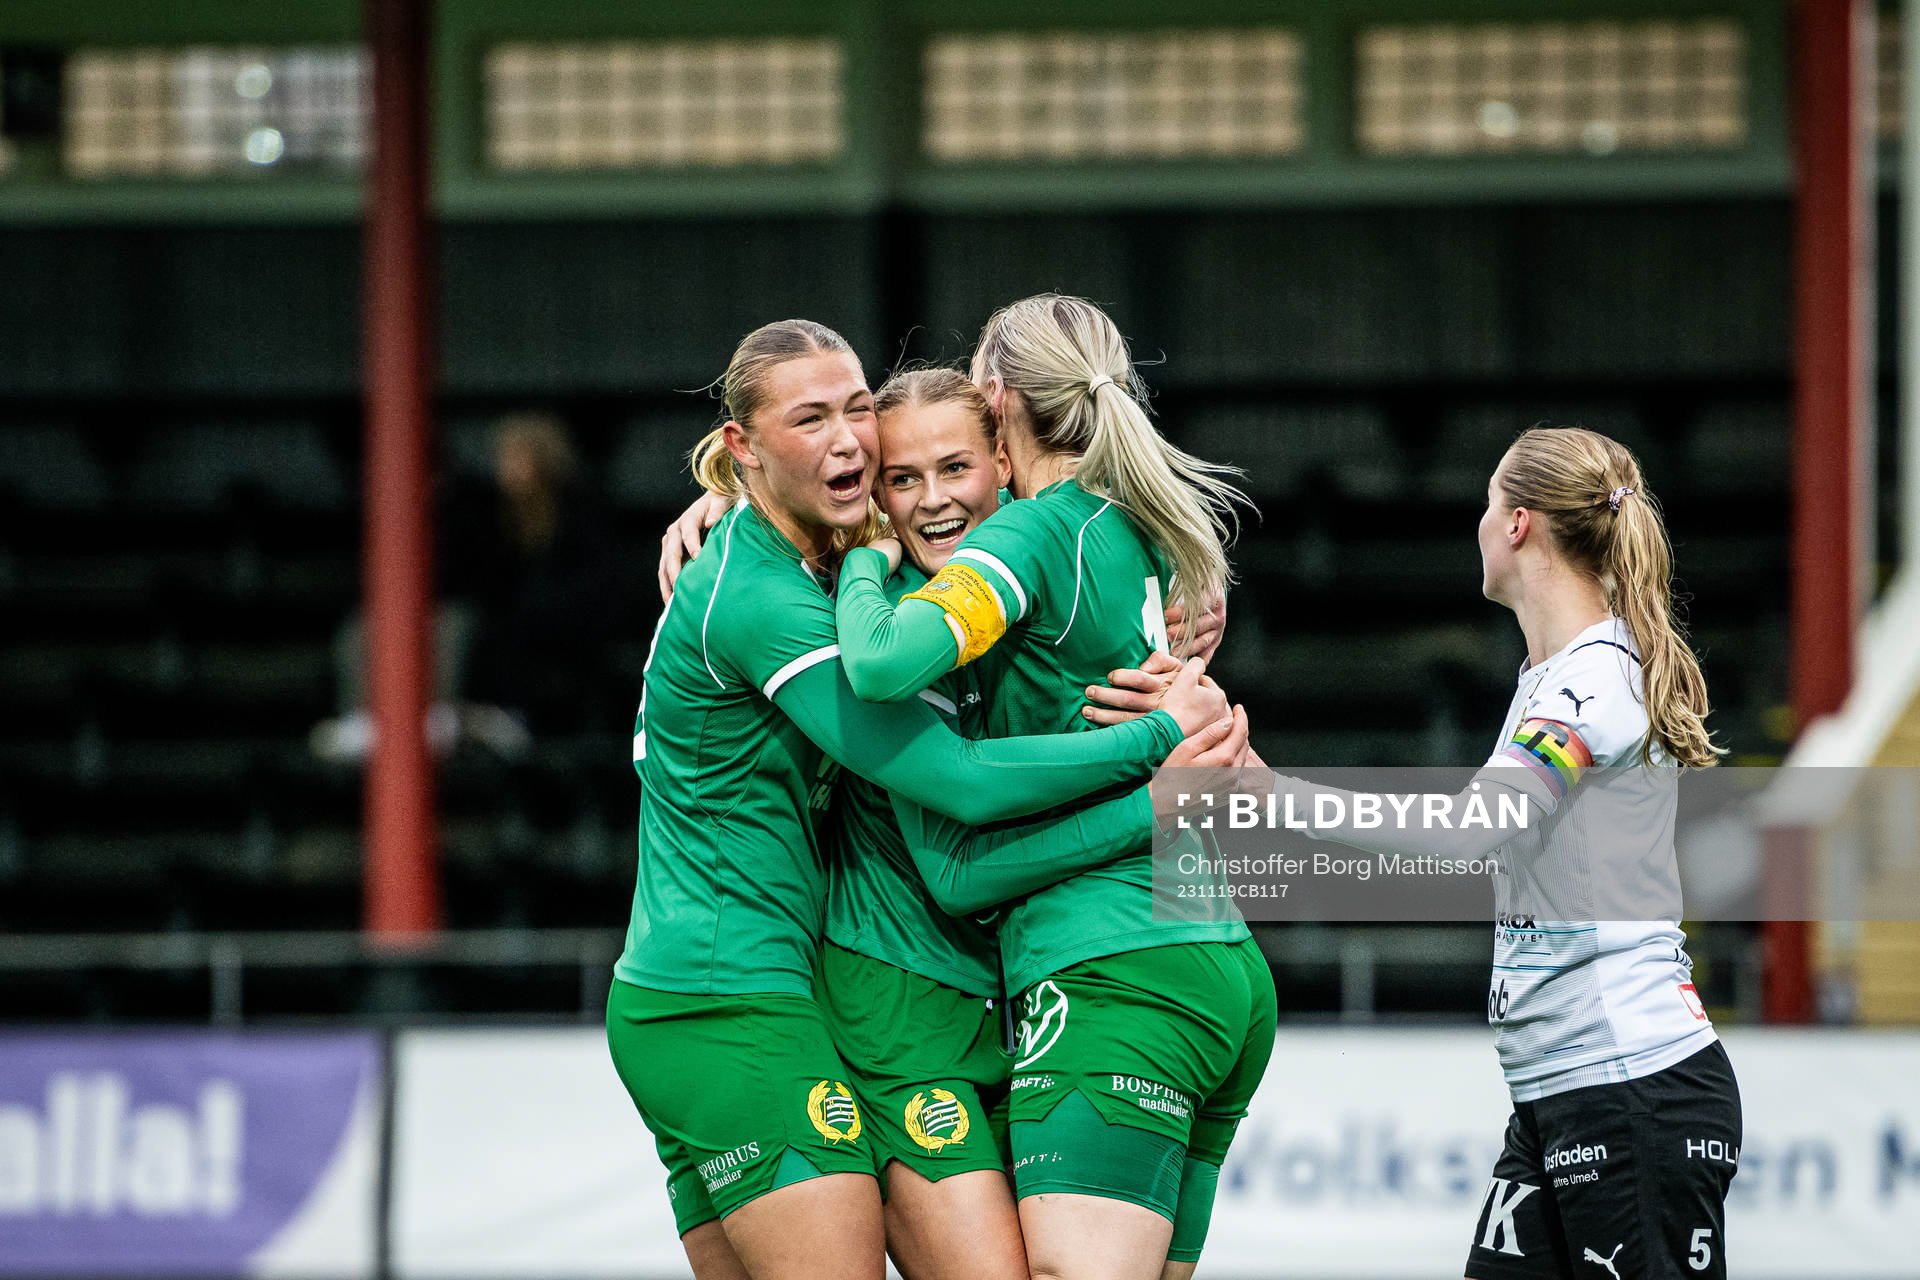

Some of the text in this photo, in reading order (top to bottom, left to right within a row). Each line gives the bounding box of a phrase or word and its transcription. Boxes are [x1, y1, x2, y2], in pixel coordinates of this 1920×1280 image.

[1112, 1074, 1194, 1107] BOSPHO
[1013, 1153, 1048, 1175] RAFT
[1544, 1143, 1608, 1173] ostaden
[1686, 1138, 1739, 1166] HOL
[1569, 1168, 1599, 1185] Umeå
[1688, 1228, 1712, 1271] 5
